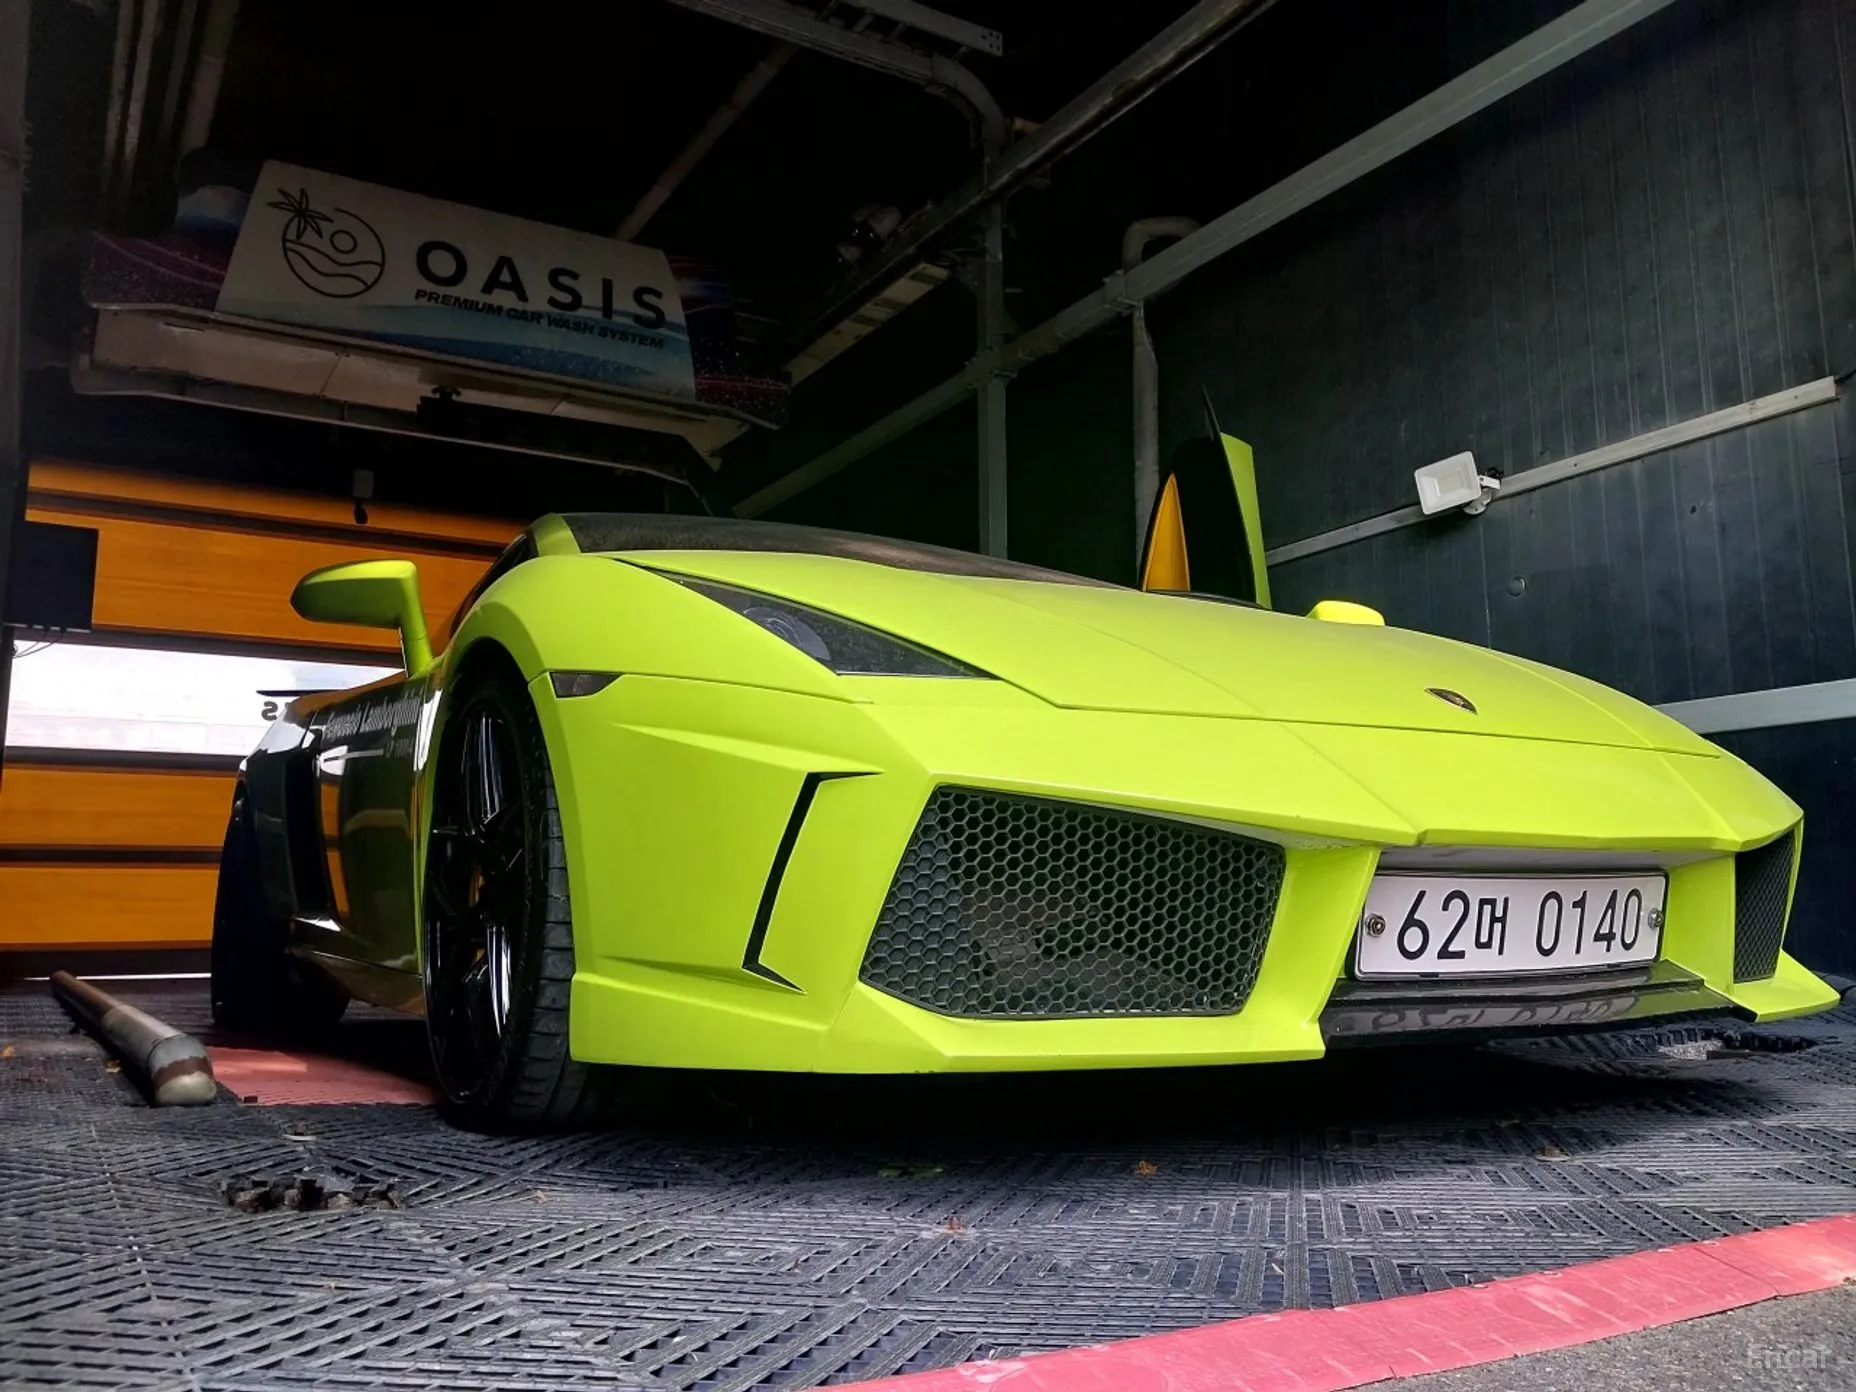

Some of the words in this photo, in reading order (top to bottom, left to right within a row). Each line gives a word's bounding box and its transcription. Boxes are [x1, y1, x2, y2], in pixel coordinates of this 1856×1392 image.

[415, 240, 667, 330] OASIS
[415, 288, 503, 316] PREMIUM
[506, 307, 542, 325] CAR
[547, 315, 595, 335] WASH
[598, 326, 665, 349] SYSTEM
[1397, 889, 1509, 961] 62머
[1535, 888, 1643, 957] 0140
